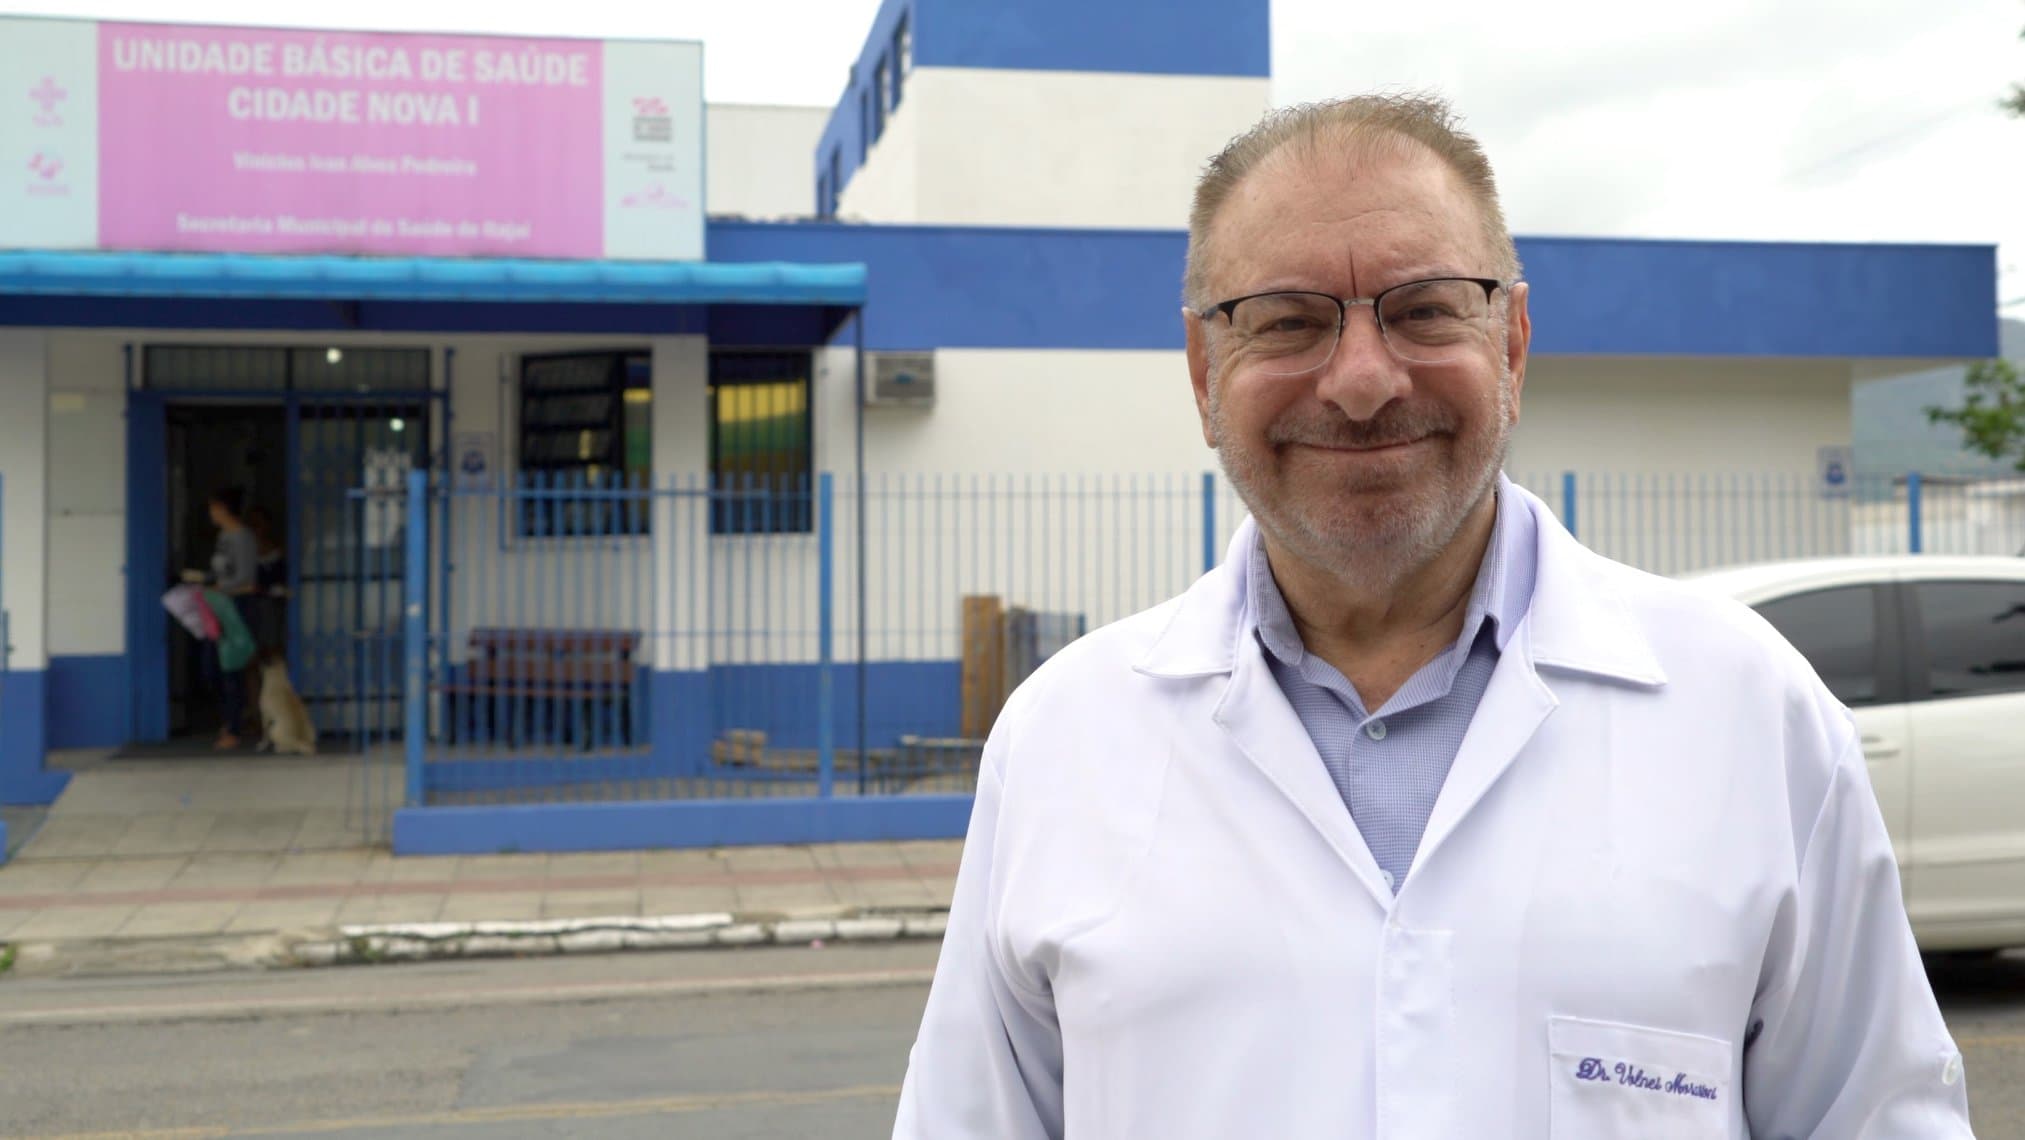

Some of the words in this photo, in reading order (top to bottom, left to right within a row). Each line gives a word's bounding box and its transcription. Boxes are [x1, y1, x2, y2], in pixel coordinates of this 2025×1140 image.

[113, 37, 274, 75] UNIDADE
[283, 36, 411, 80] BÁSICA
[420, 48, 465, 81] DE
[473, 45, 588, 86] SAÚDE
[228, 86, 359, 122] CIDADE
[368, 91, 459, 125] NOVA
[467, 94, 480, 124] I
[1576, 1057, 1610, 1081] Dr.
